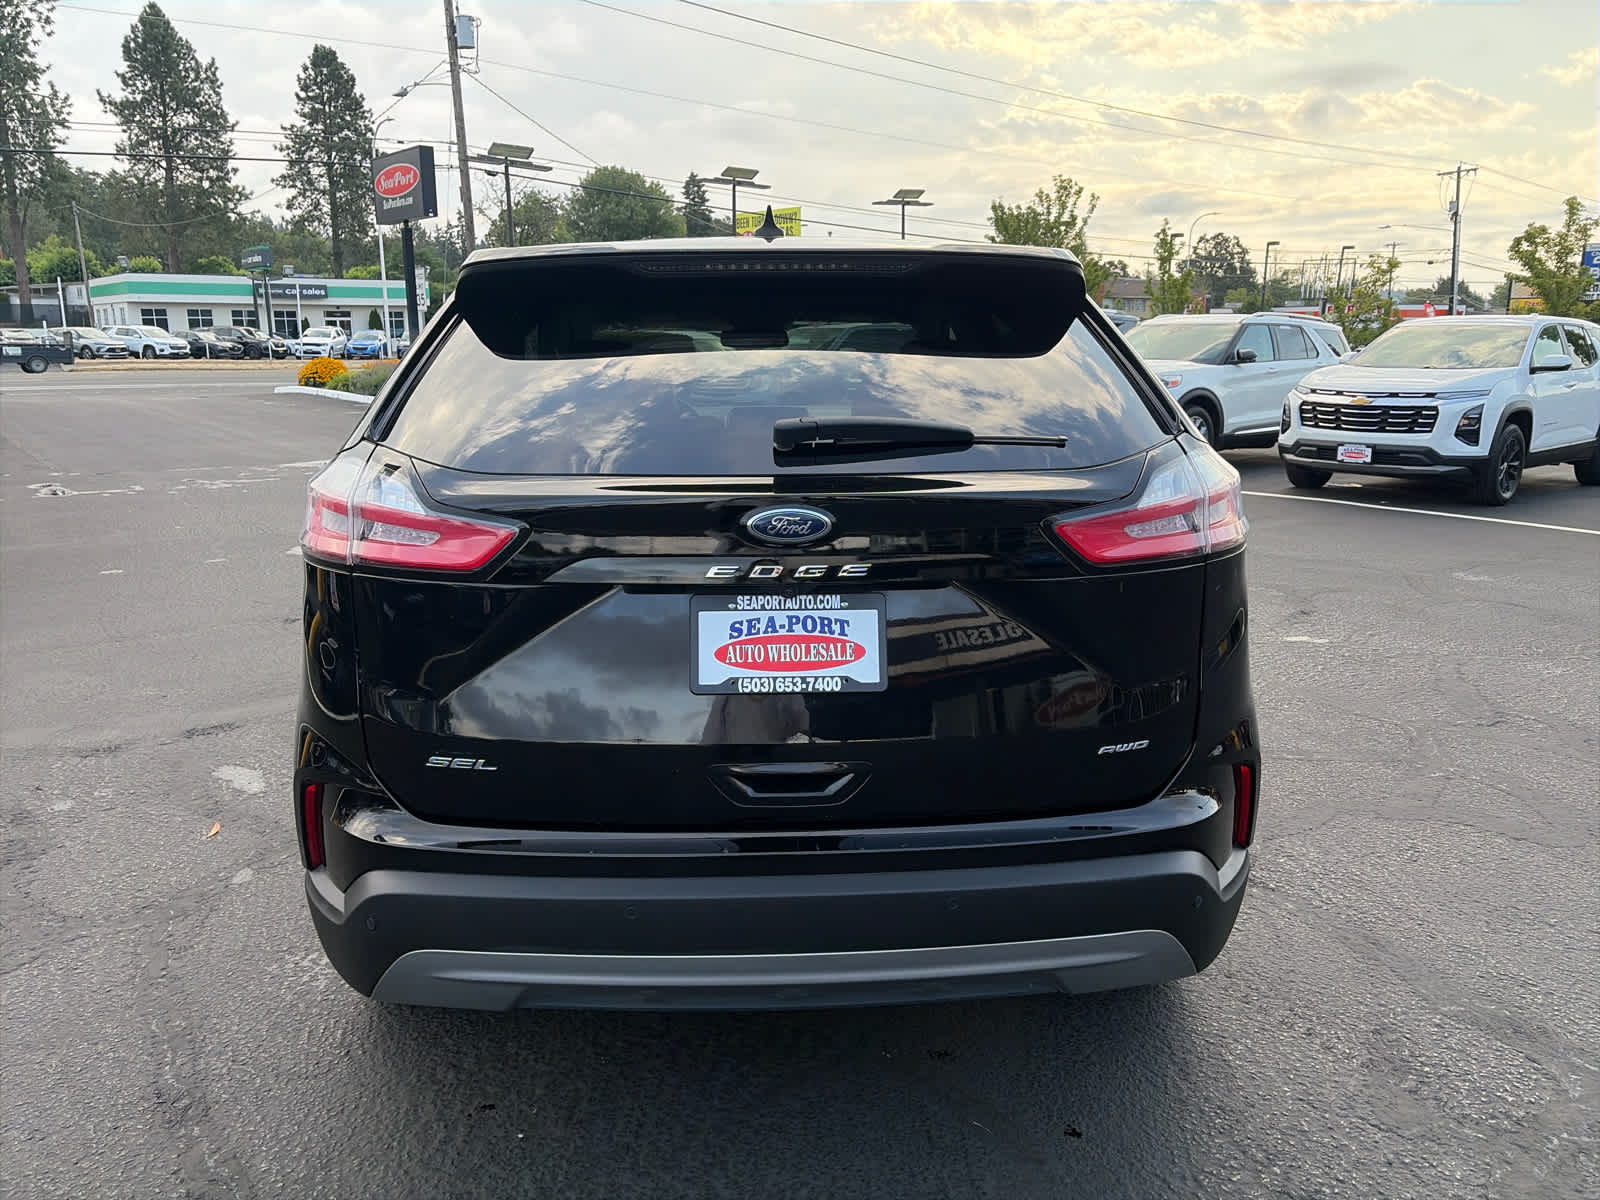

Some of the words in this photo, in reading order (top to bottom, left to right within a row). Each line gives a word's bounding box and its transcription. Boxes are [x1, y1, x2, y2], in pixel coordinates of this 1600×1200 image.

[379, 169, 415, 192] SeaPort
[302, 287, 326, 295] sales
[767, 515, 813, 535] Ford
[705, 563, 872, 578] EDGE
[736, 594, 841, 610] SEAPORTAUTO.COM
[728, 614, 850, 640] SEA-PORT
[725, 644, 765, 664] AUTO
[766, 642, 855, 663] WHOLESALE
[737, 677, 774, 693] (503)
[775, 676, 842, 692] 653-7400
[1097, 740, 1150, 754] AWD
[425, 756, 498, 770] SEL
